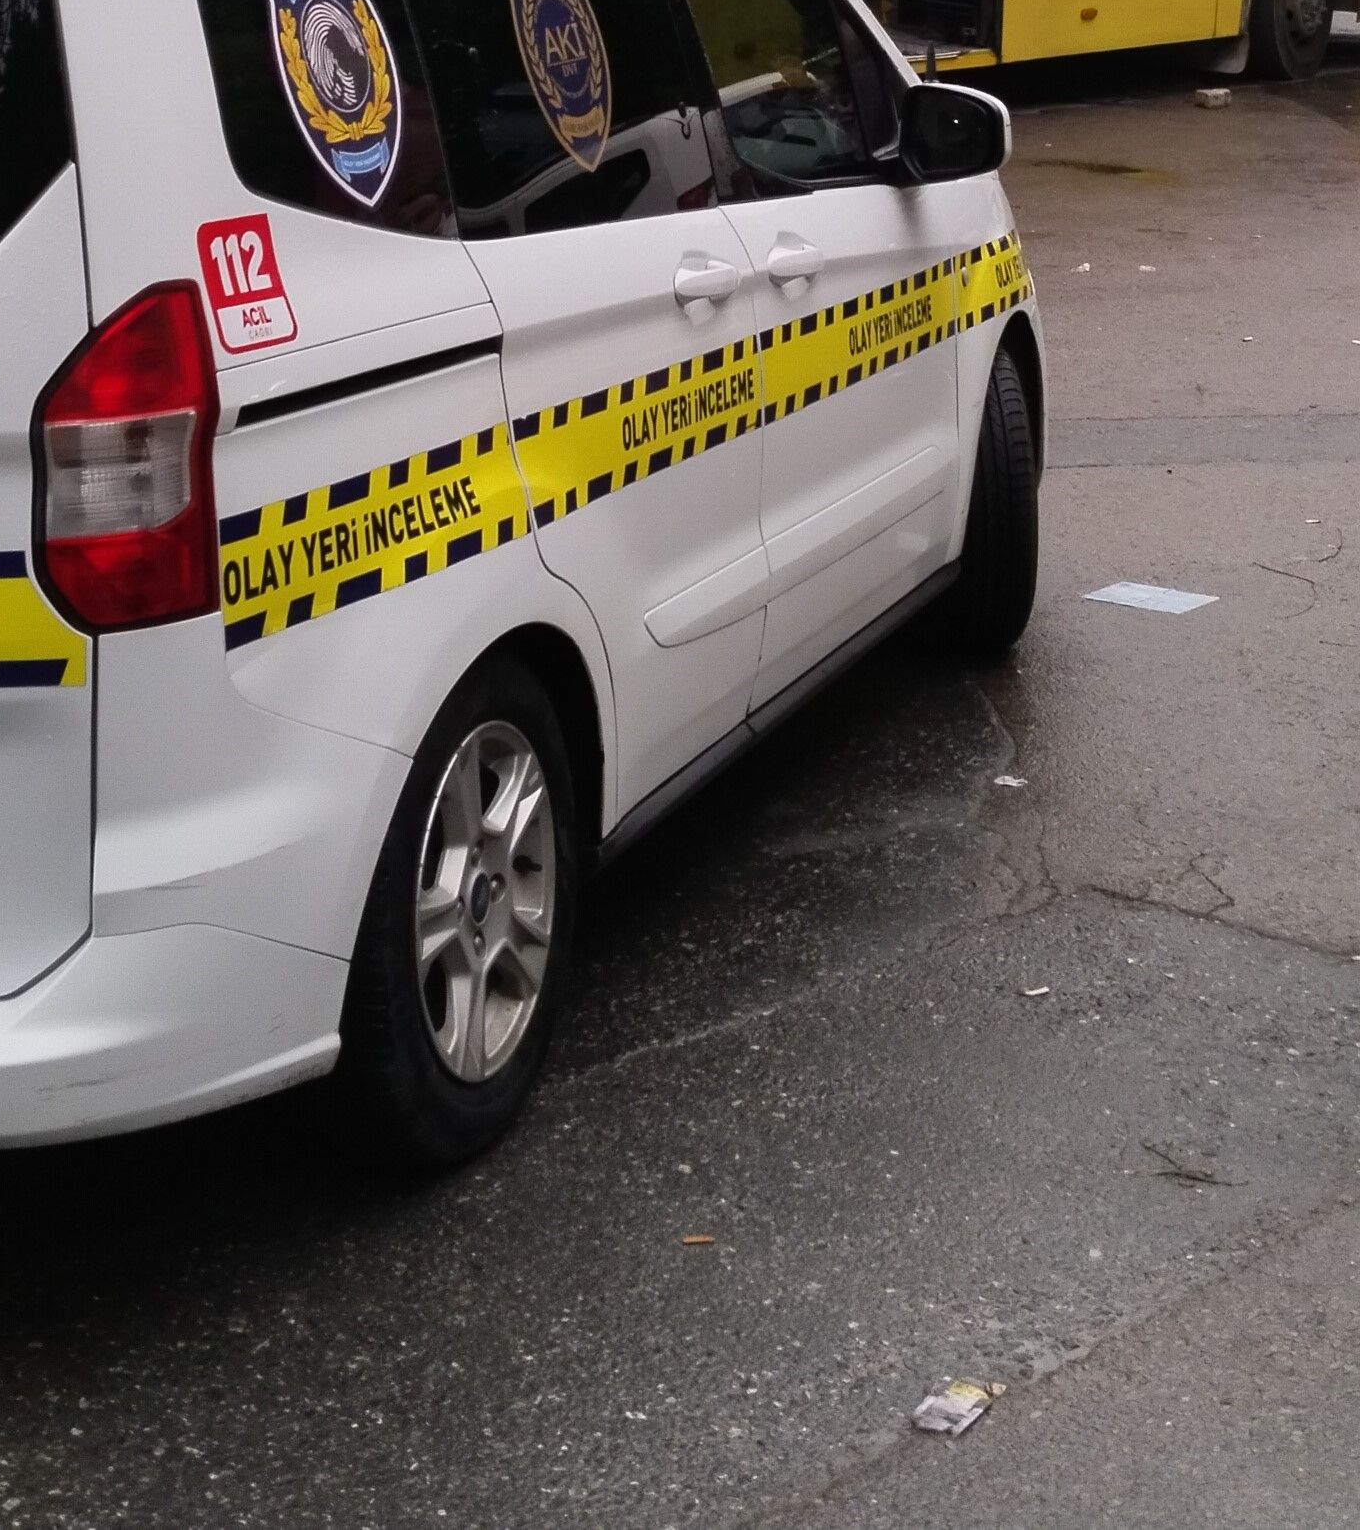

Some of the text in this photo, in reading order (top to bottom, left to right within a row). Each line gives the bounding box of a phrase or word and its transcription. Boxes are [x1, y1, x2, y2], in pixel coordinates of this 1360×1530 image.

[210, 230, 273, 297] 112
[848, 319, 872, 357] OLAY
[622, 367, 755, 451] OLAY YERİ İNCELEME
[223, 475, 482, 606] OLAY YERİ İNCELEME
